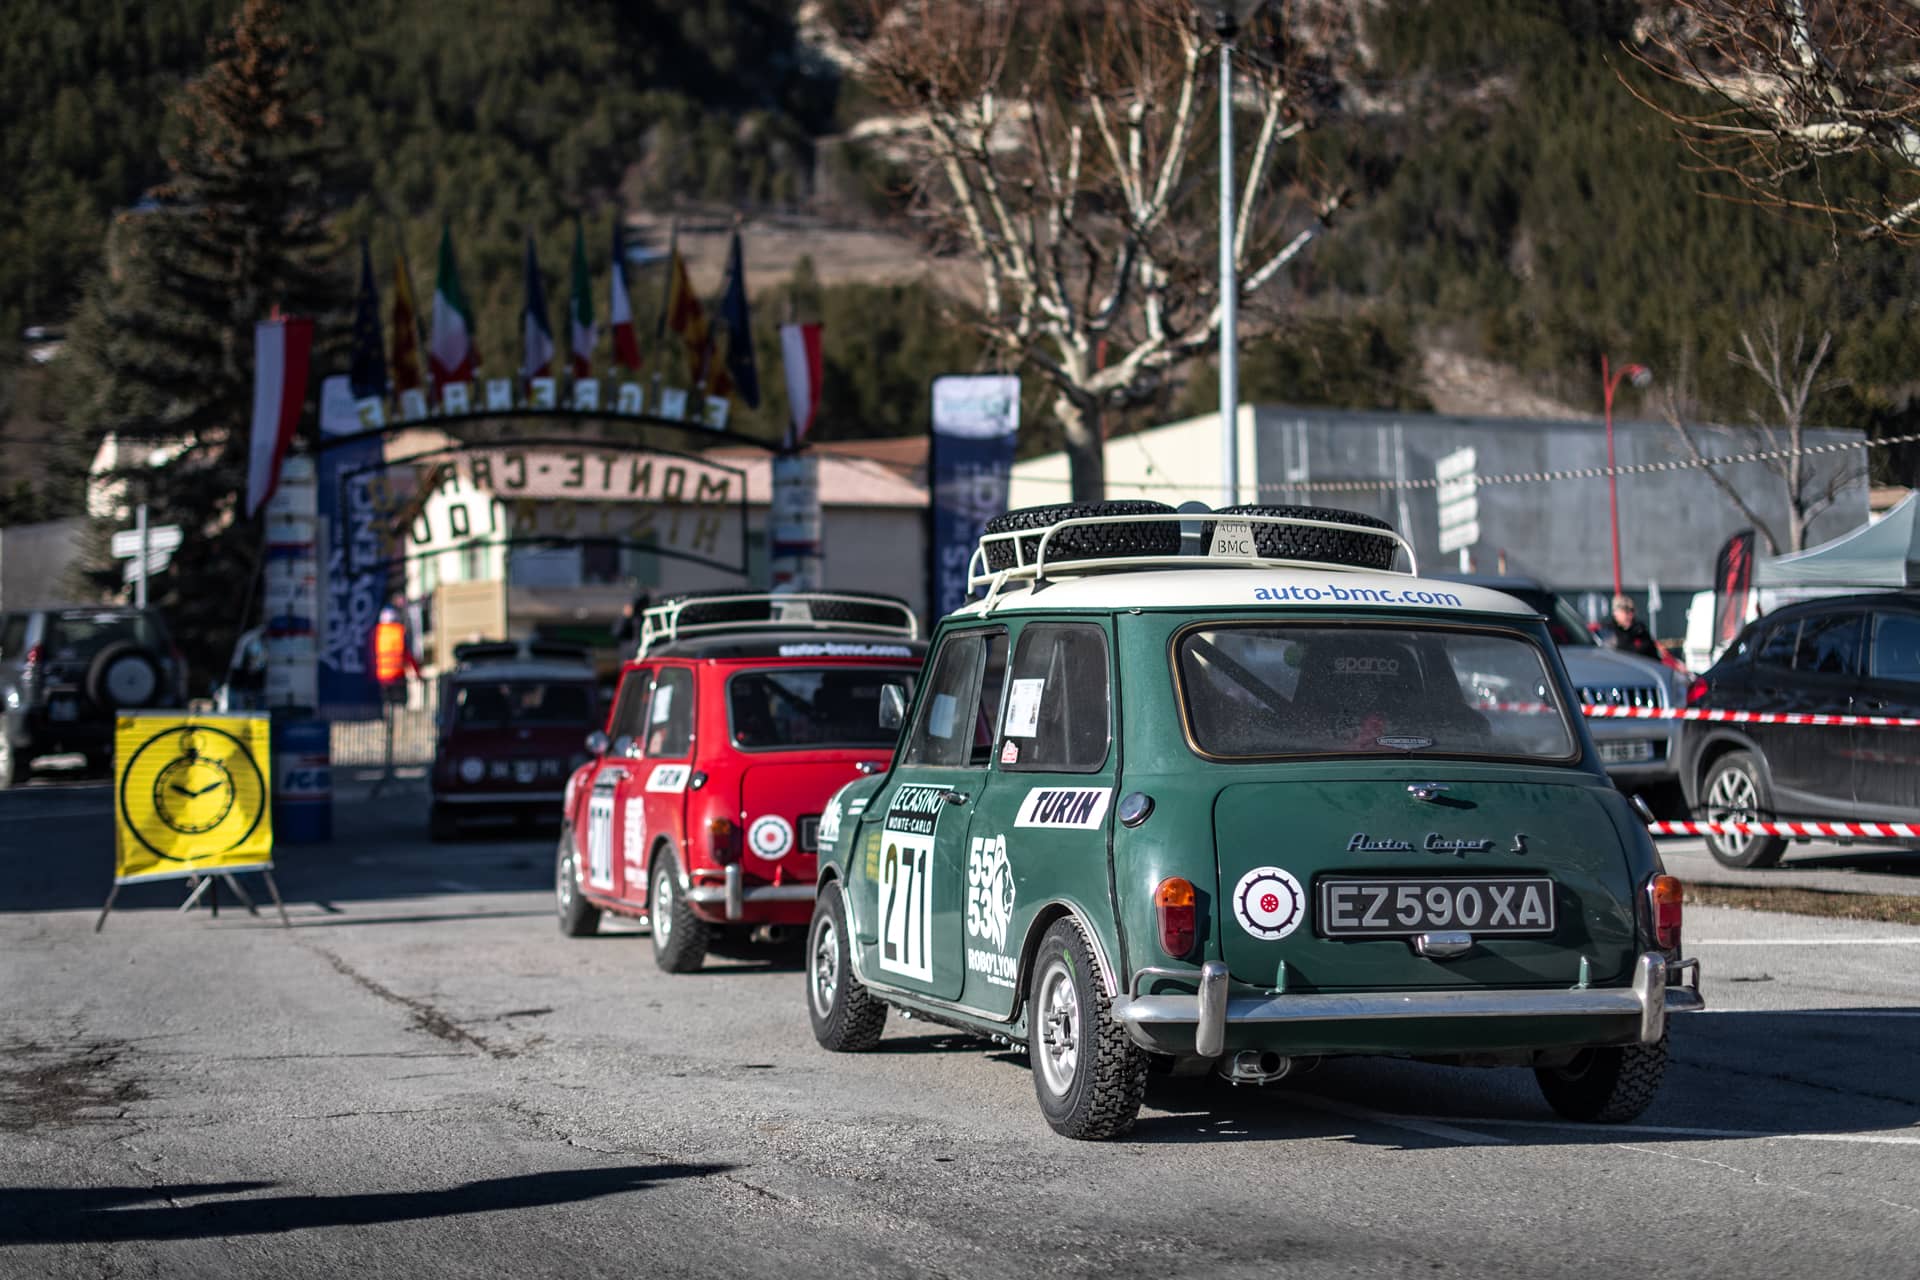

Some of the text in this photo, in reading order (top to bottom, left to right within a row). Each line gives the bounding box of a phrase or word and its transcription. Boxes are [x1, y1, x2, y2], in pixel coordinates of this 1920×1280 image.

[1220, 523, 1248, 533] AUTO
[1217, 540, 1249, 554] BMC
[1254, 584, 1463, 607] auto-bmc.com
[1334, 656, 1400, 676] sparco
[901, 787, 943, 815] CASINO
[1029, 791, 1102, 824] TURIN
[887, 816, 933, 834] MONTE-CARLO
[1347, 832, 1528, 856] Austin Cooper S
[968, 836, 997, 888] 55
[884, 842, 926, 969] 271
[967, 886, 994, 940] 53
[967, 948, 1018, 979] ROBO'LYON
